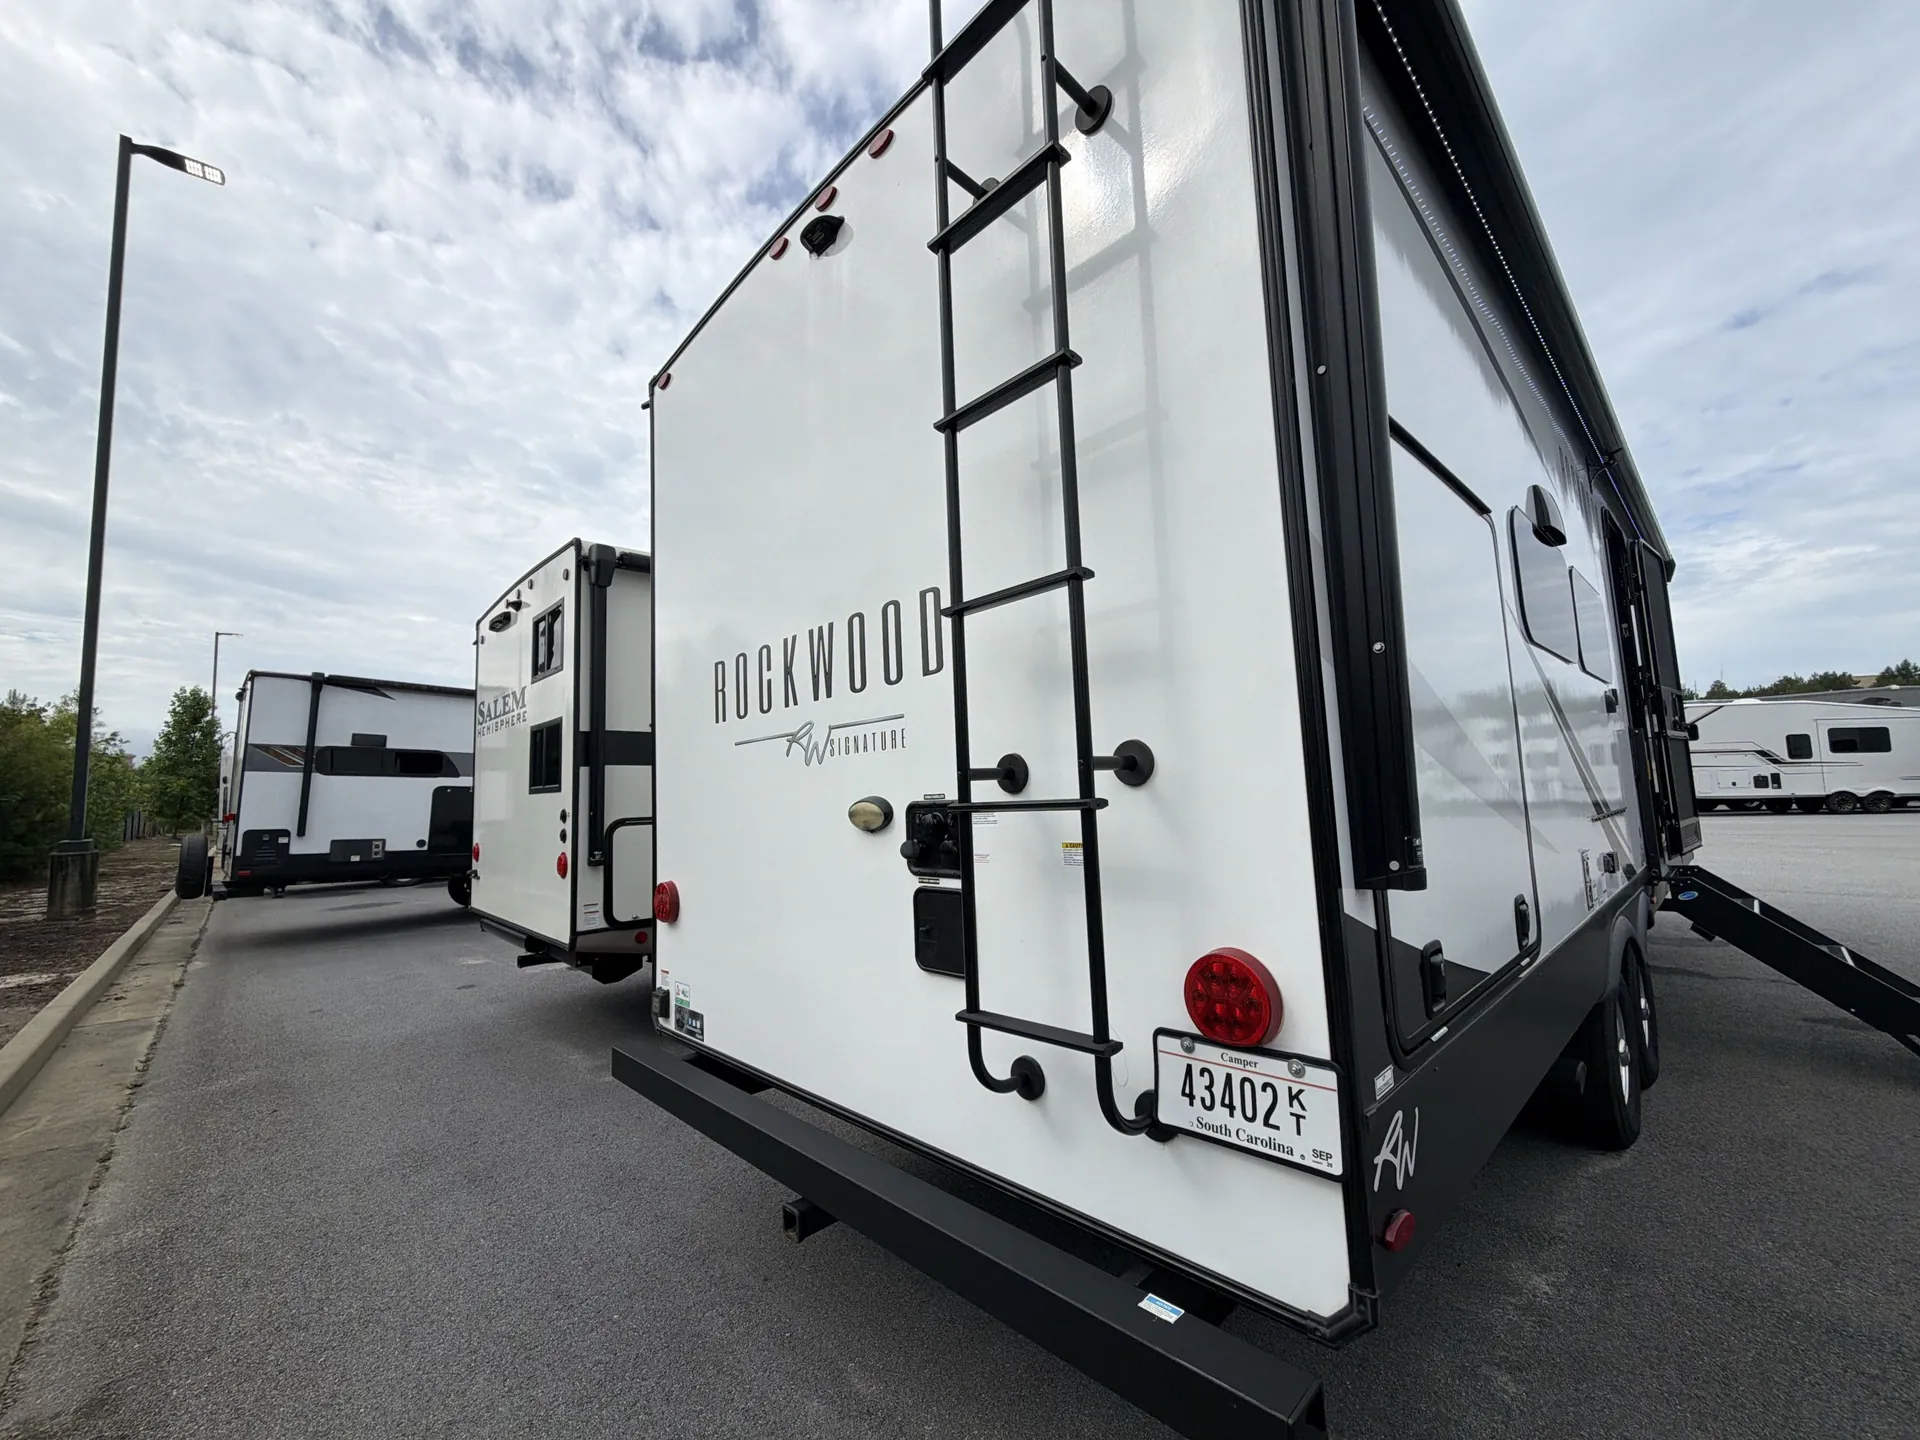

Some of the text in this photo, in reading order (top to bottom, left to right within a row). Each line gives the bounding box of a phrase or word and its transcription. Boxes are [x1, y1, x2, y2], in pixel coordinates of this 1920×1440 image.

[714, 586, 944, 725] ROCKWOOD
[477, 685, 527, 726] SALEM
[477, 710, 527, 738] HEMISPHERE
[829, 728, 906, 757] SIGNATURE
[1220, 1052, 1259, 1069] Camper
[1180, 1063, 1281, 1131] 43402
[1196, 1116, 1295, 1157] South Carolina
[1311, 1148, 1333, 1161] SEP
